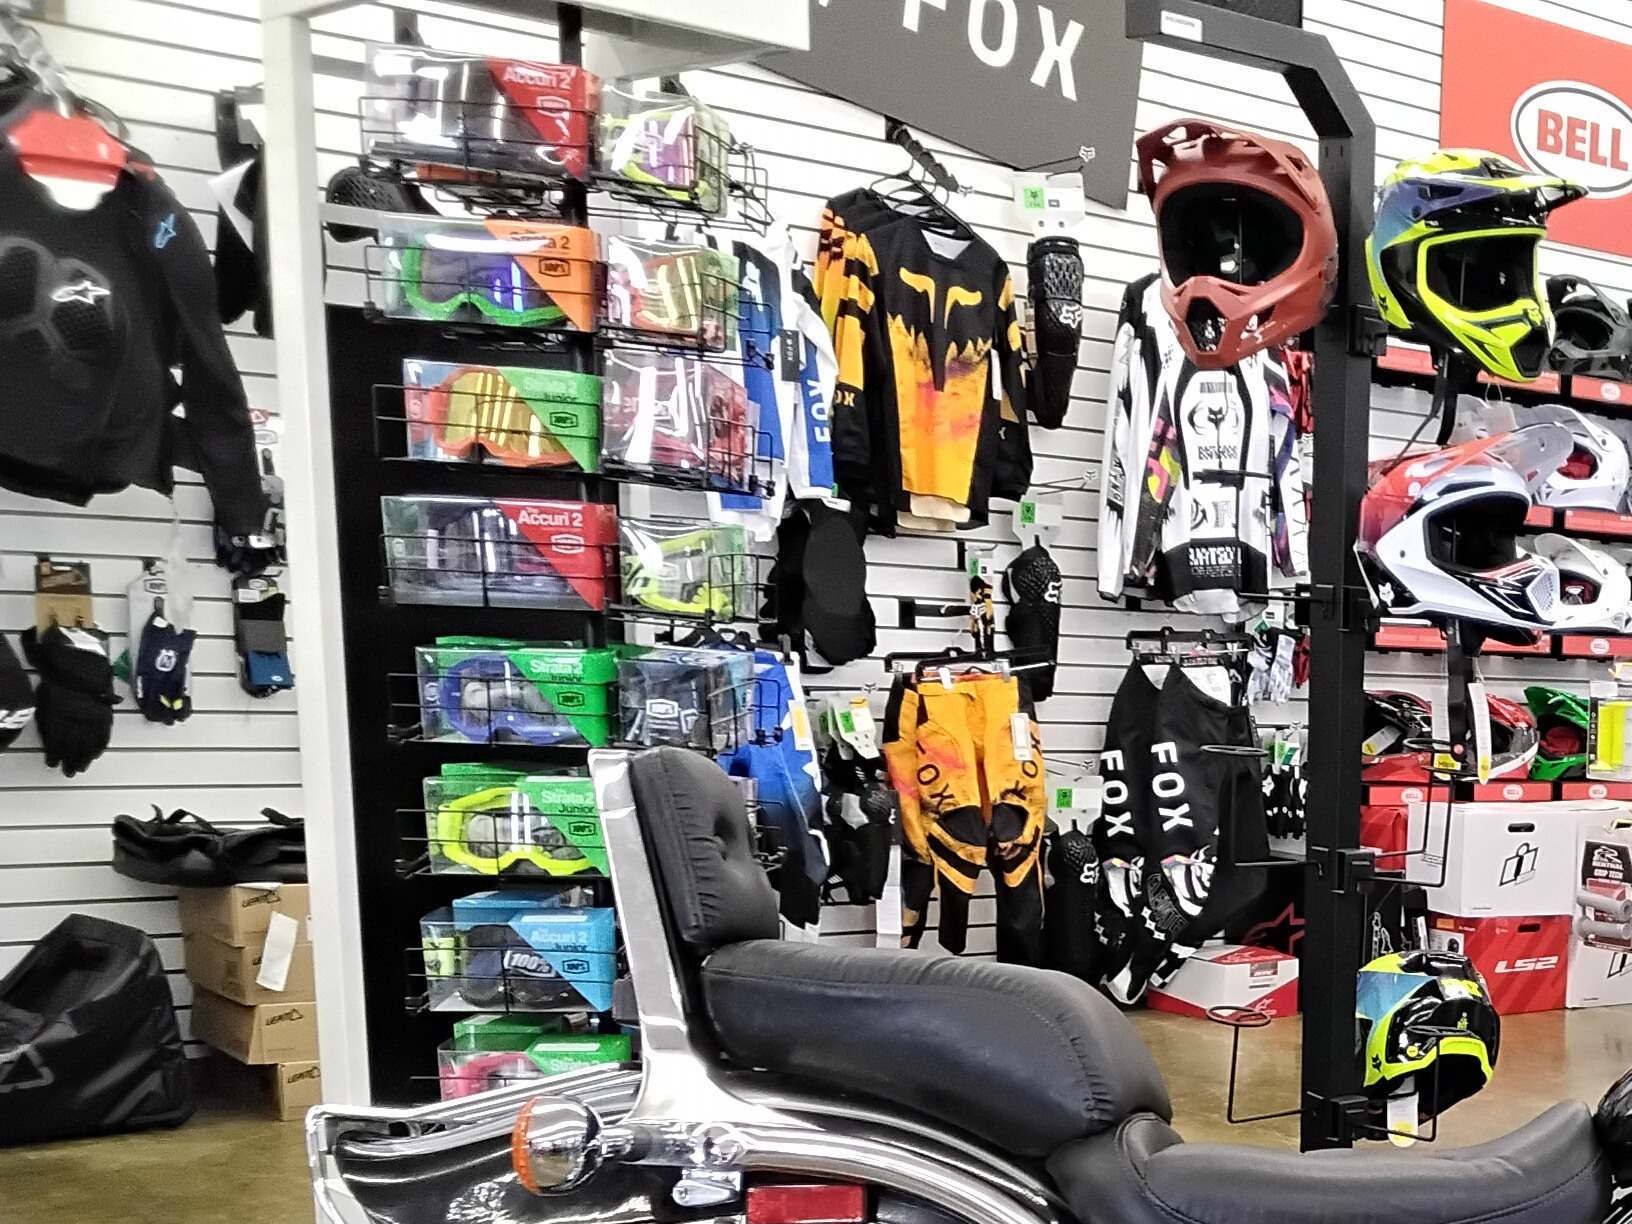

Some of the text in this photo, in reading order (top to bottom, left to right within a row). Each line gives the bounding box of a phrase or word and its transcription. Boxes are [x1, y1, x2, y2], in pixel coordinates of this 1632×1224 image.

[1537, 108, 1628, 172] BELL
[518, 510, 583, 527] Accuri 2
[1100, 749, 1135, 838] FOX
[1151, 741, 1194, 832] FOX
[558, 803, 594, 813] Junior
[1592, 860, 1625, 871] RENTHAL
[530, 930, 588, 943] Accuri 2
[510, 953, 551, 973] 100%
[1495, 956, 1559, 973] LS2
